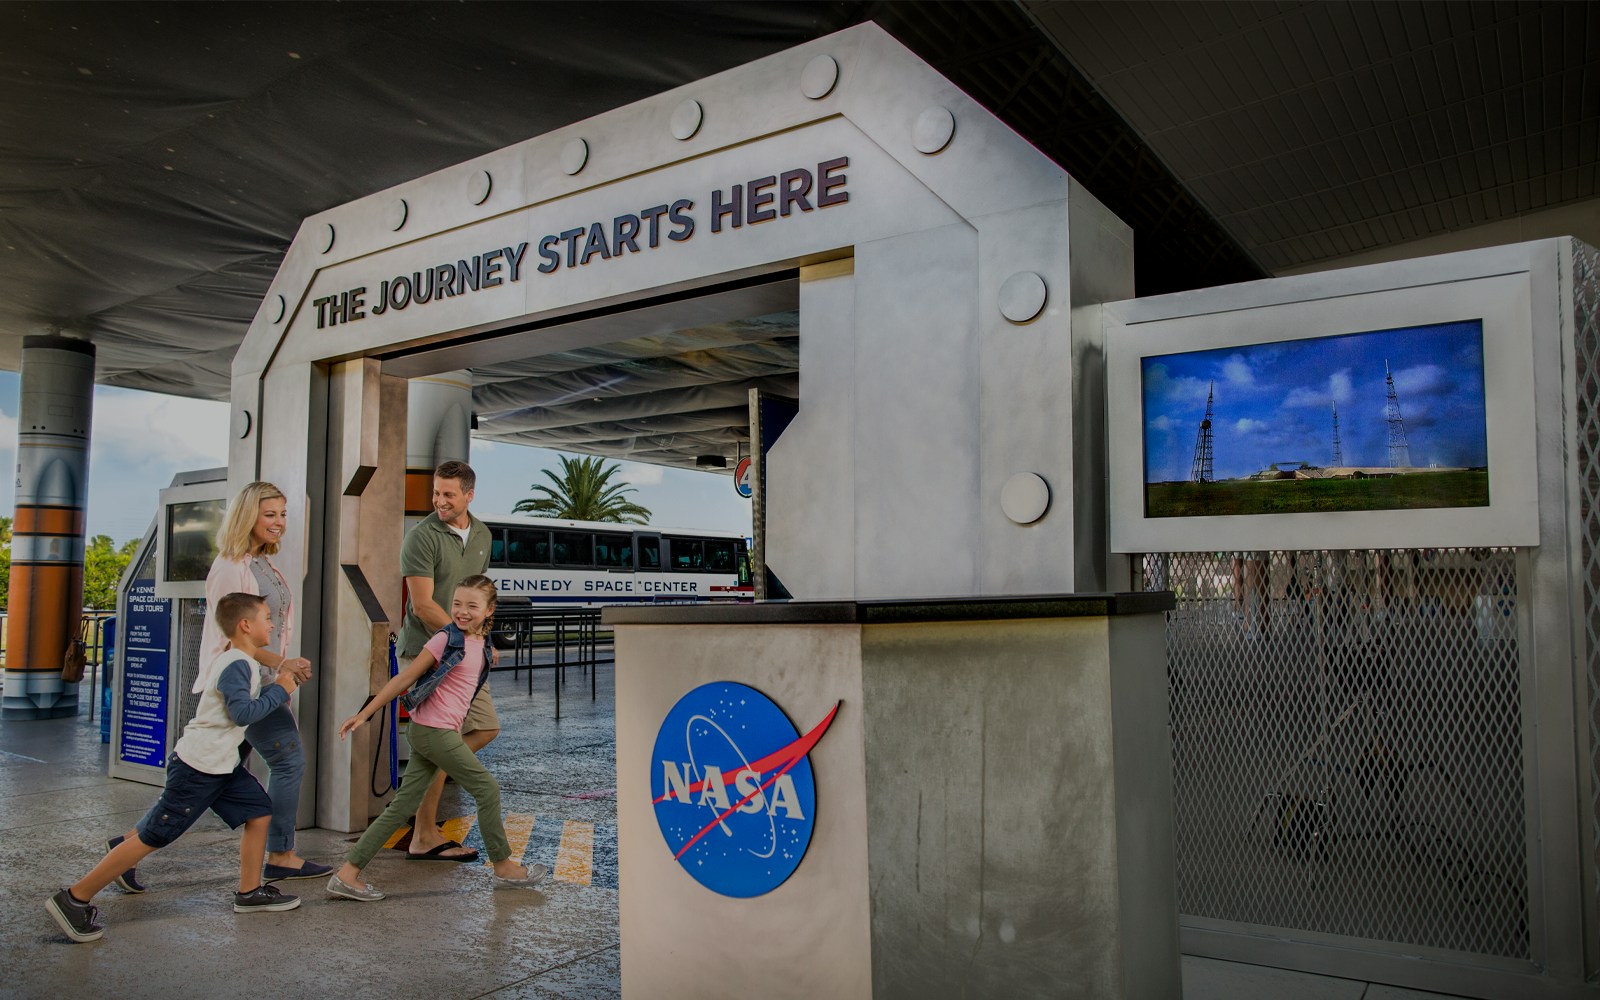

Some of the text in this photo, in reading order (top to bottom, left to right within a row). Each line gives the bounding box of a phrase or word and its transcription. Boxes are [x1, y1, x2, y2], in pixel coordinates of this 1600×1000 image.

[313, 156, 851, 329] THE JOURNEY STARTS HERE
[584, 580, 633, 592] SPACE
[643, 581, 697, 592] CENTER
[662, 760, 806, 820] NASA
